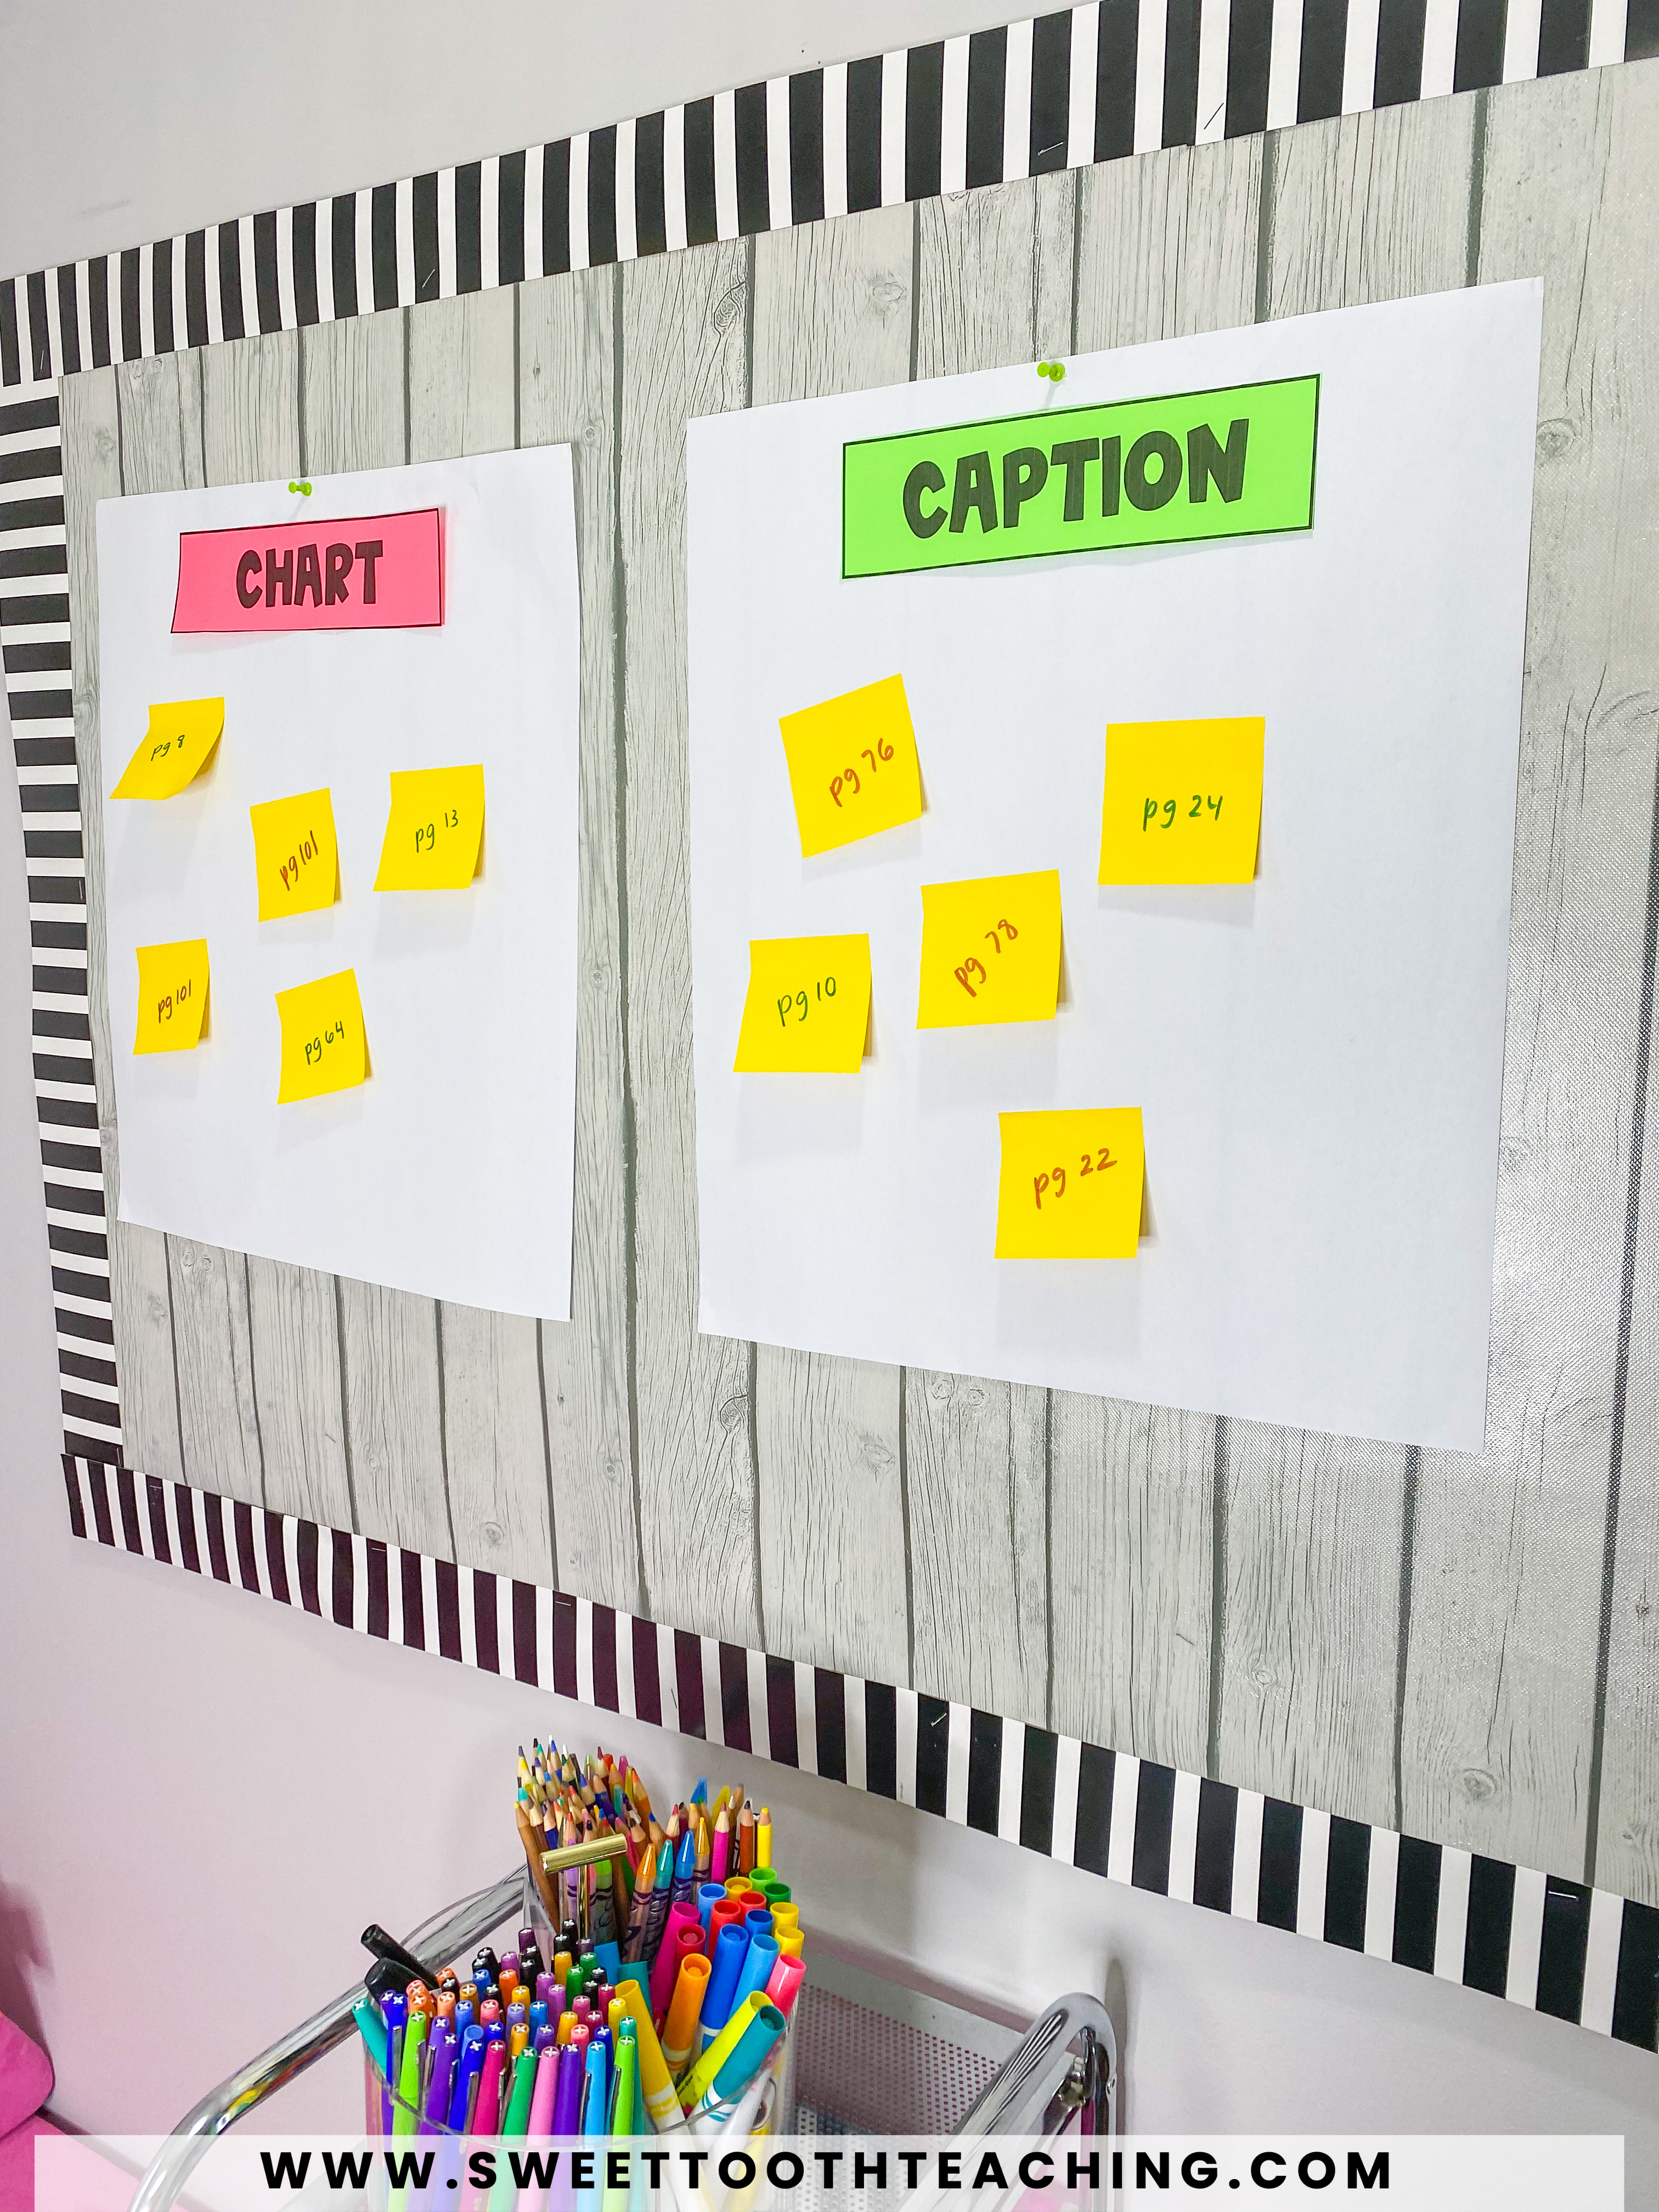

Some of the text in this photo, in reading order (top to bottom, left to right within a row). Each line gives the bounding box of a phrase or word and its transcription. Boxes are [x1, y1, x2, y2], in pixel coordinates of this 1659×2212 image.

[903, 419, 1249, 538] CAPTION
[236, 540, 383, 608] CHART
[177, 734, 185, 748] 8
[829, 737, 894, 808] pg 76
[415, 809, 459, 854] pg 13
[1142, 794, 1223, 832] pg 24
[953, 919, 1019, 998] pg 78
[1034, 1148, 1118, 1210] pg 22
